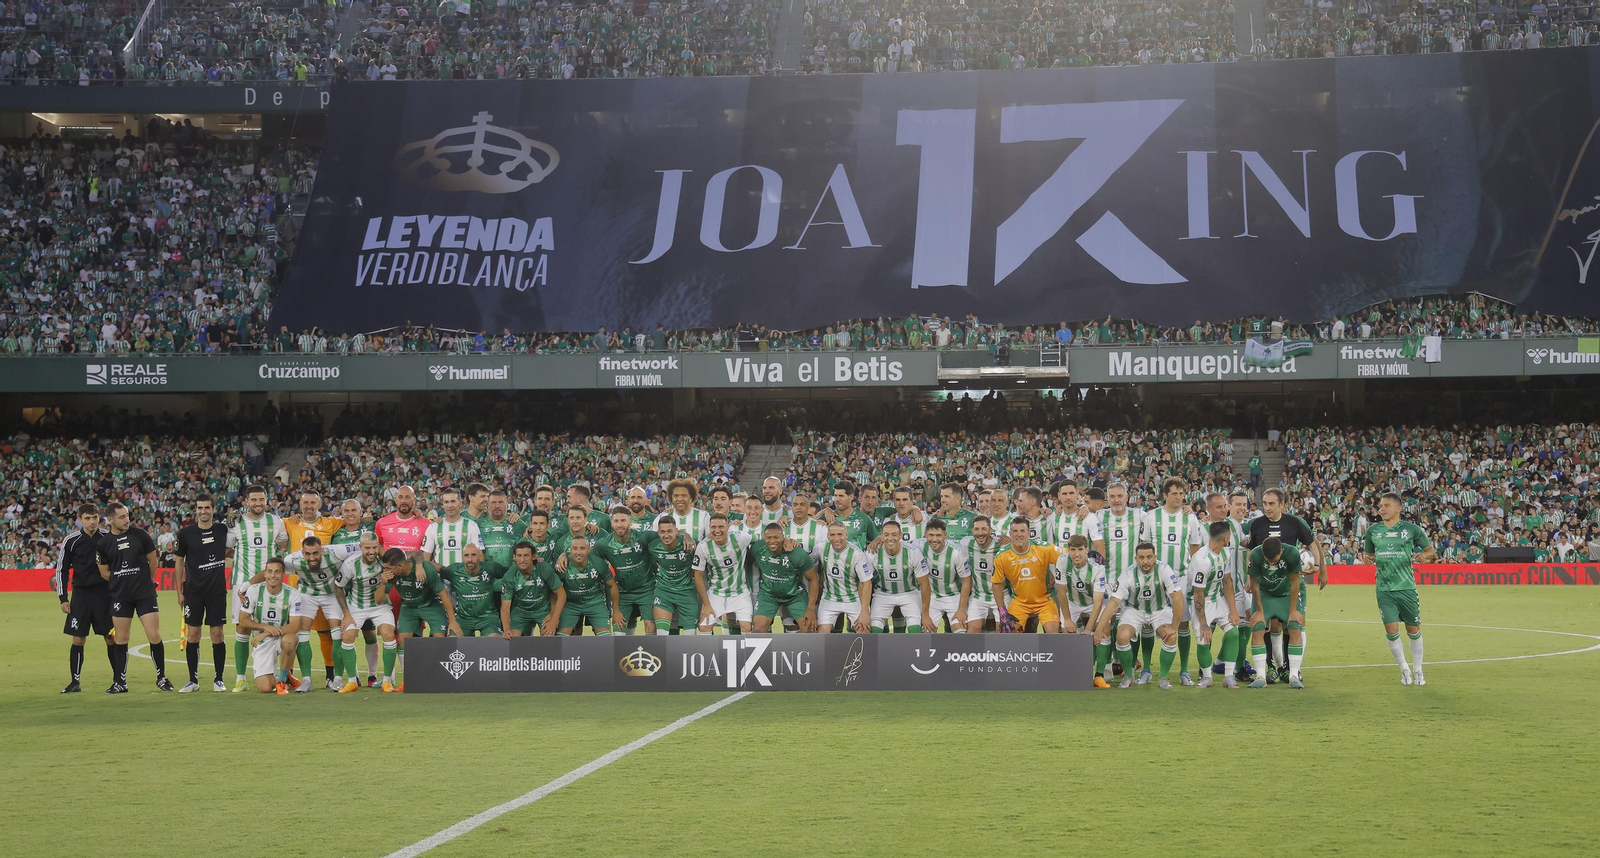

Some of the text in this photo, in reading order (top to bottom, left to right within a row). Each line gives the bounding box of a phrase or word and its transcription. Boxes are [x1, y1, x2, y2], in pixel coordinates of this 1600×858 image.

[361, 213, 555, 253] LEYENDA
[355, 251, 549, 293] VERDIBLANCA
[110, 363, 168, 376] REALE
[598, 355, 679, 371] finetwork
[724, 354, 903, 384] Viva el Betis
[1357, 360, 1410, 376] FIBRA Y MÓVIL
[258, 364, 340, 381] Cruzcampo
[449, 364, 508, 380] hummel
[614, 372, 664, 387] FIBRA Y MÓVIL
[110, 376, 168, 386] SEGUROS
[944, 649, 1054, 663] JOAQUÍNSÁNCHEZ
[479, 655, 581, 674] Real Betis Balompié
[959, 664, 1038, 673] FUNDACIÓN
